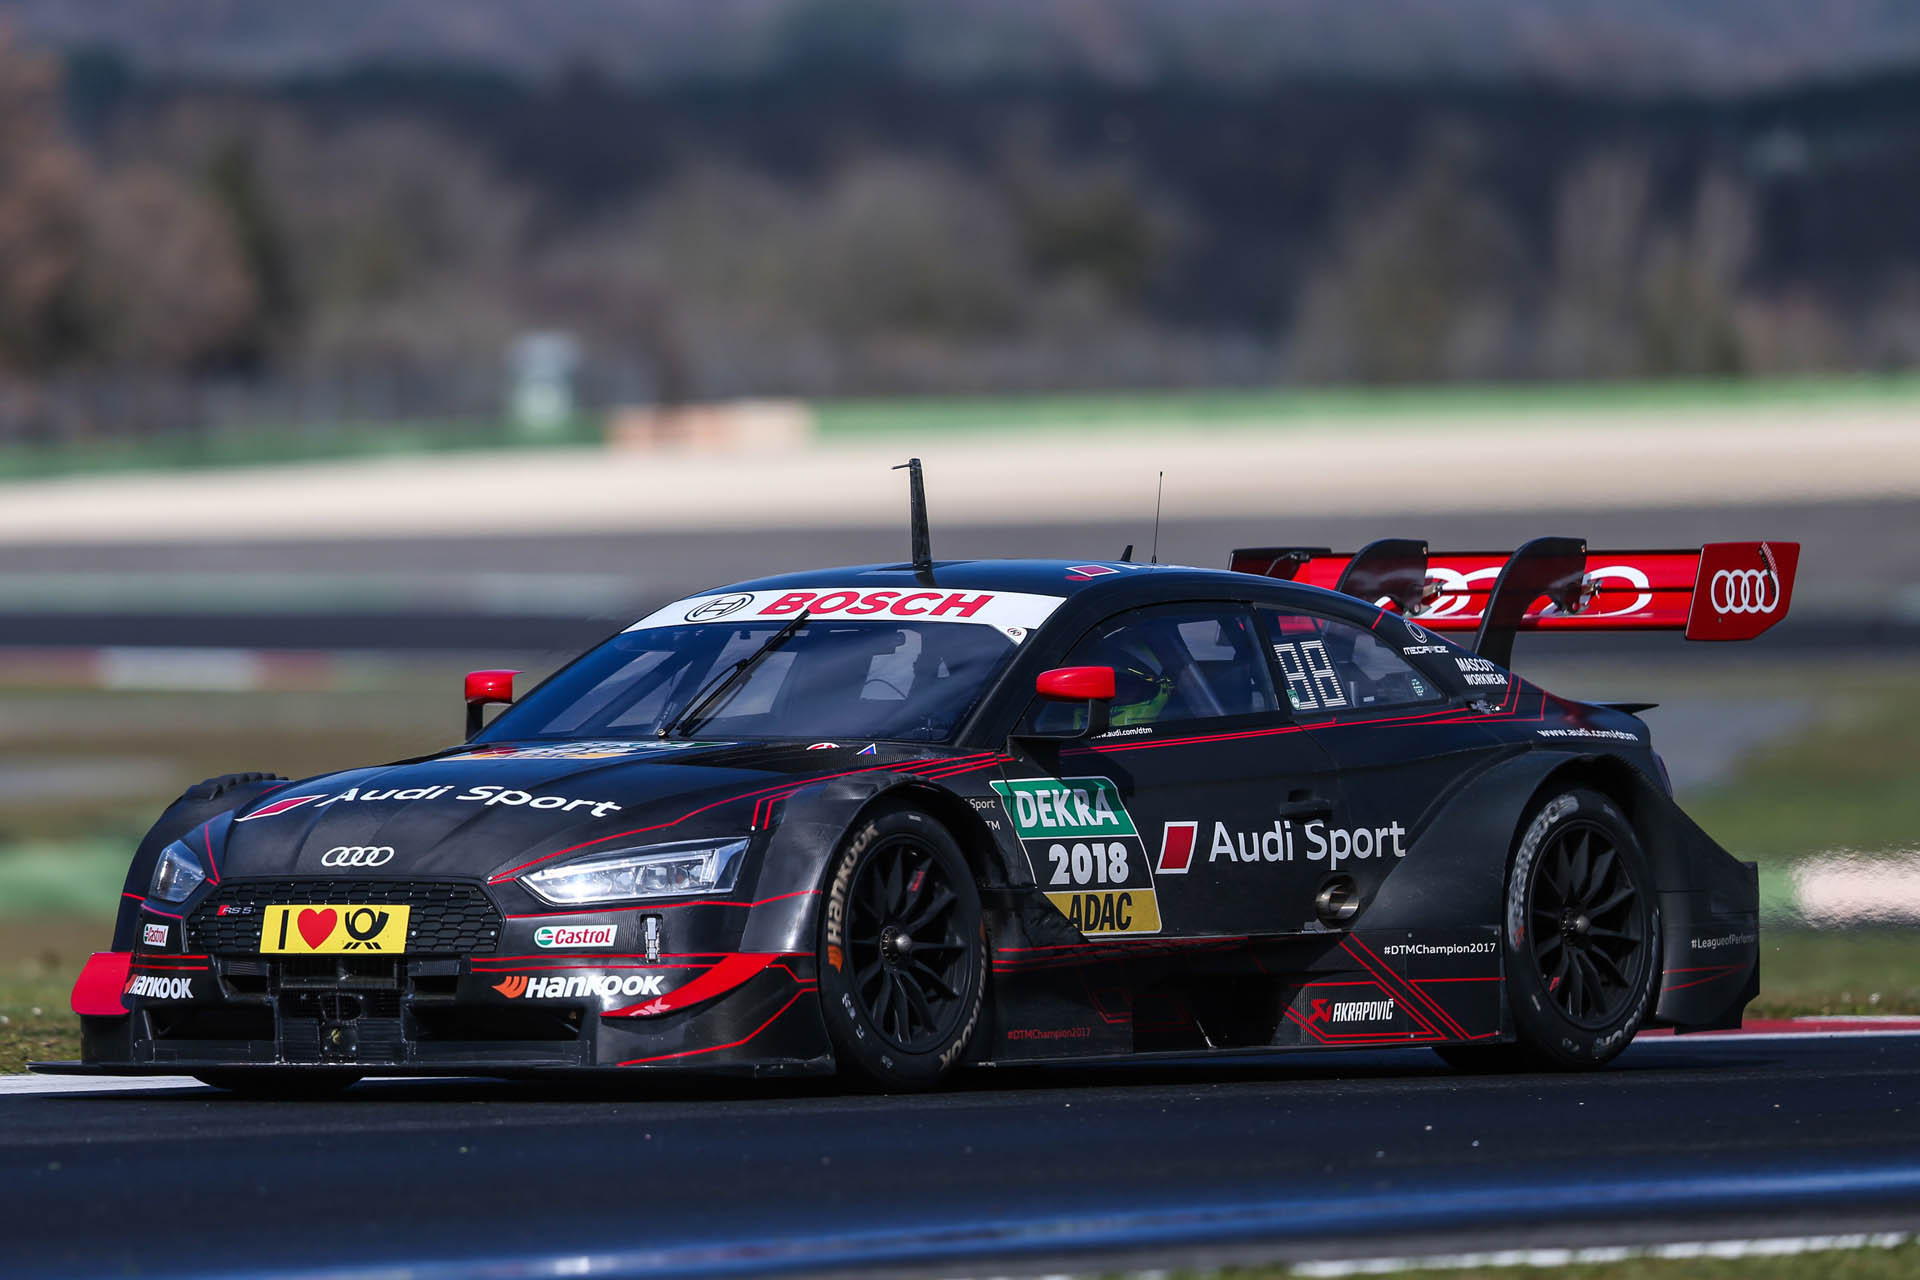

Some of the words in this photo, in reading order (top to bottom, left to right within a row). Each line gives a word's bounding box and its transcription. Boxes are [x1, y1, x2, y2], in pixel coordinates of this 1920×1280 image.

[757, 591, 995, 618] BOSCH
[1454, 657, 1495, 672] MASCOT
[1463, 673, 1508, 686] WORKWEAR
[1091, 727, 1153, 739] w.audi.com/dtm
[1537, 728, 1638, 741] www.audi.com/dtm
[314, 785, 455, 807] Audi
[455, 785, 622, 818] Sport
[1014, 787, 1120, 828] DEKRA
[1208, 821, 1294, 862] Audi
[1304, 821, 1407, 870] Sport
[1048, 842, 1129, 885] 2018
[1068, 893, 1132, 931] ADAC
[554, 928, 611, 944] Castrol
[1383, 943, 1497, 955] #DTMChampion2017
[1007, 1026, 1091, 1040] #DTMChampion2017
